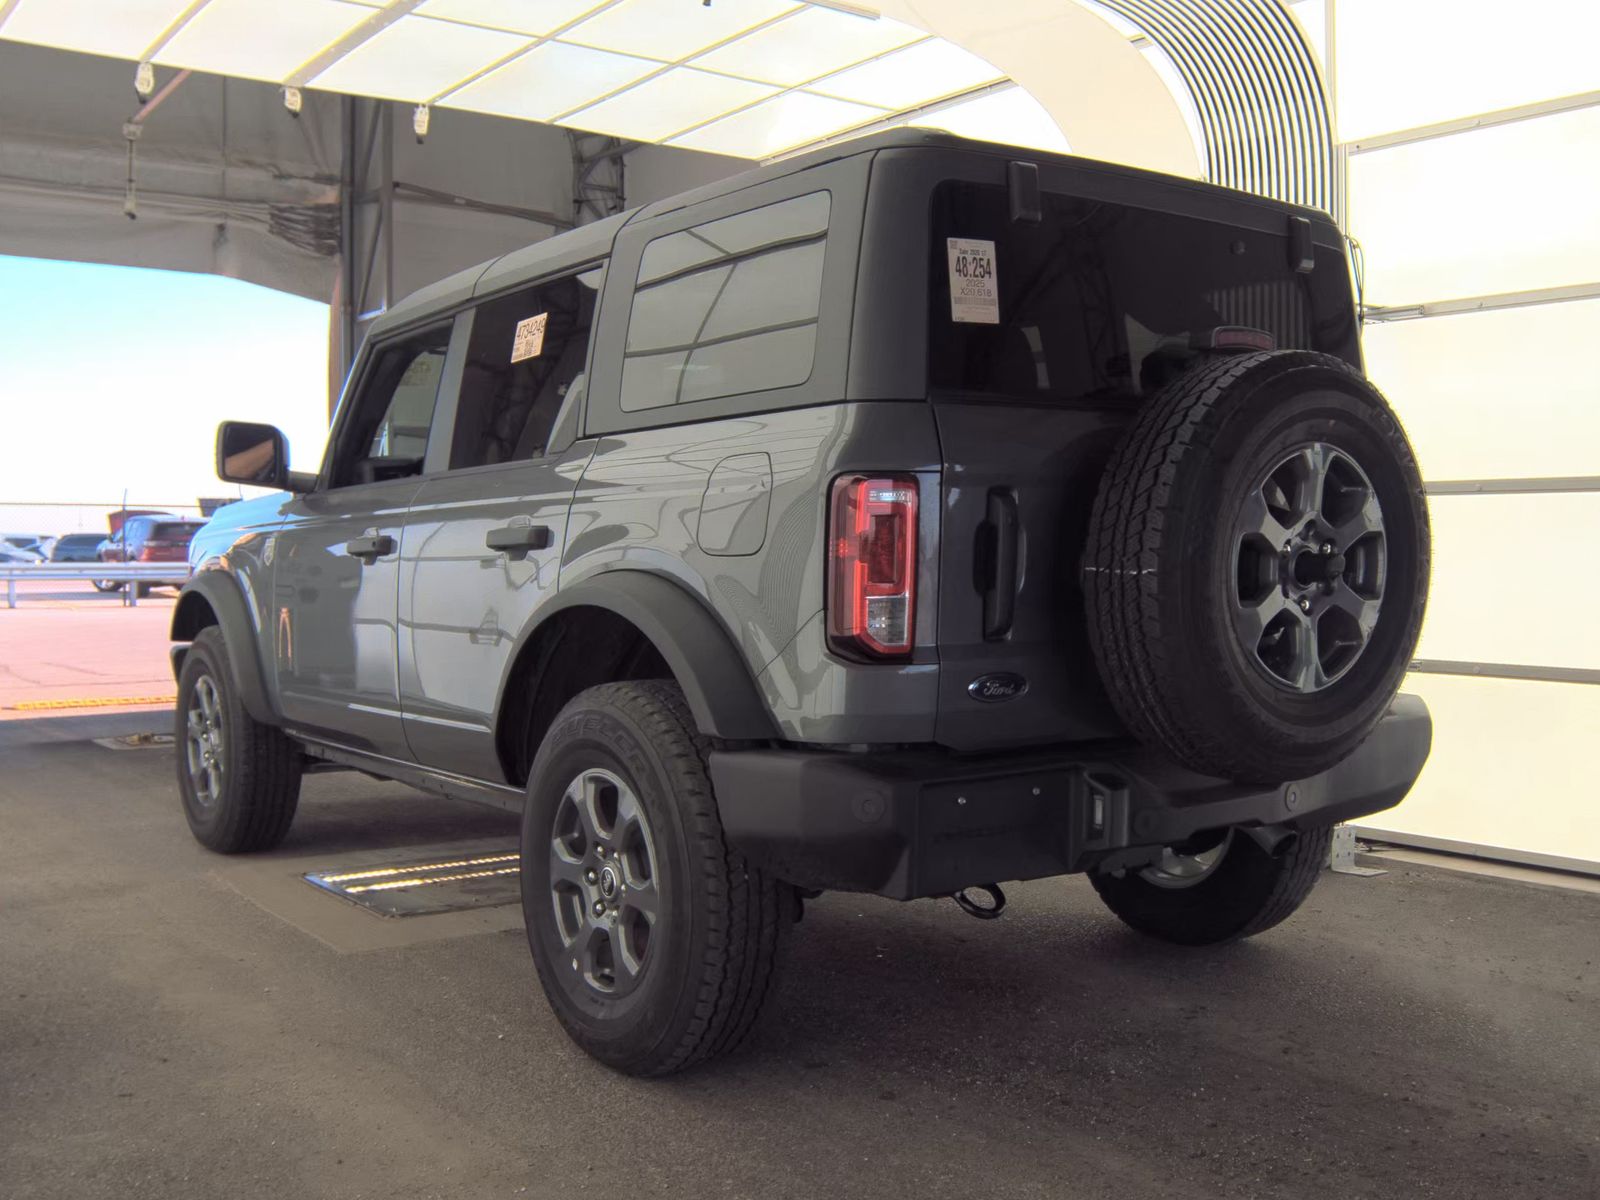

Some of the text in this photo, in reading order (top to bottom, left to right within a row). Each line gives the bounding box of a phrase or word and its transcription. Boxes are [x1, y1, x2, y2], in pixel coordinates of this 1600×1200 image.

[955, 256, 992, 279] 48:254
[966, 278, 985, 288] 2025
[984, 680, 1014, 696] Ford
